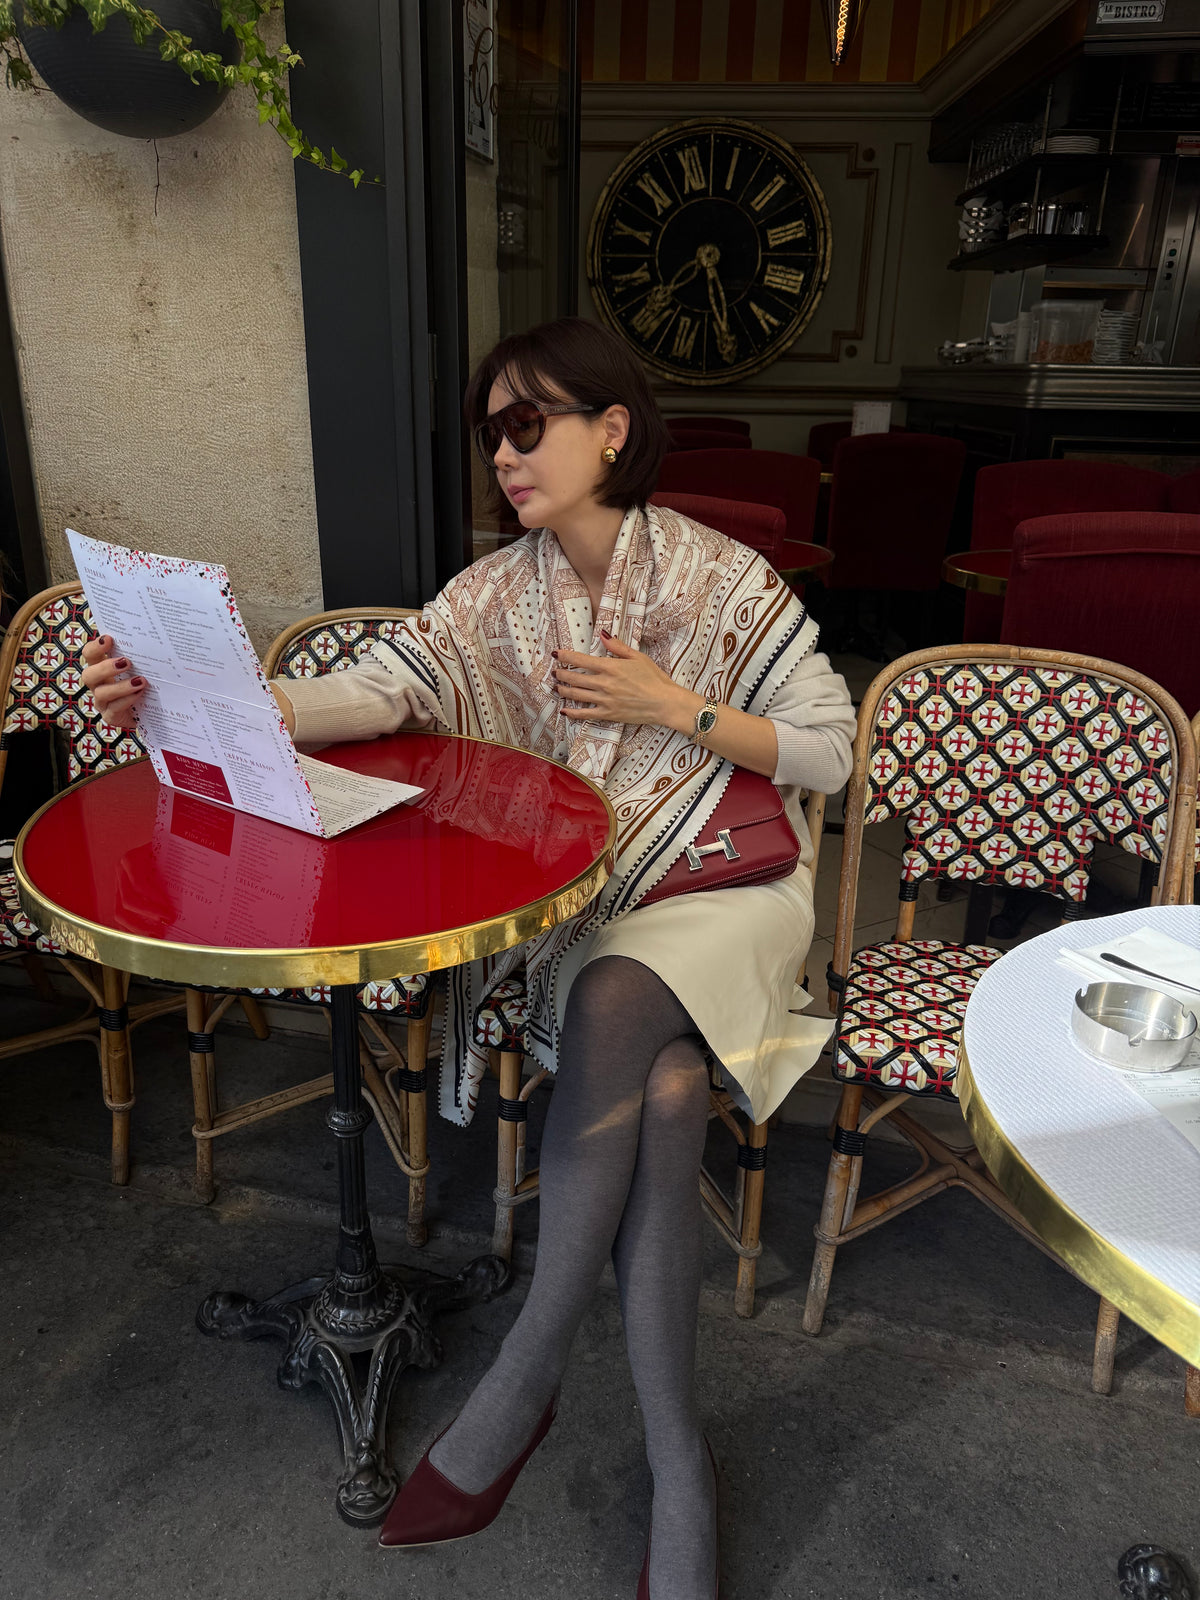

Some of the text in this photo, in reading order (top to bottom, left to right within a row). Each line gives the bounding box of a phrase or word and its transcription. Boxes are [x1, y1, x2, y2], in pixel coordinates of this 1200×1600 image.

[1114, 4, 1157, 19] BISTRO
[676, 146, 707, 195] XII
[725, 147, 741, 191] I
[636, 172, 673, 217] XI
[750, 173, 787, 212] II
[612, 218, 652, 247] X
[766, 219, 807, 249] III
[749, 302, 781, 336] V
[146, 586, 167, 597] PLATS
[200, 696, 234, 711] DESSERTS
[175, 756, 209, 770] KIDS MENU
[249, 759, 276, 772] MAISON
